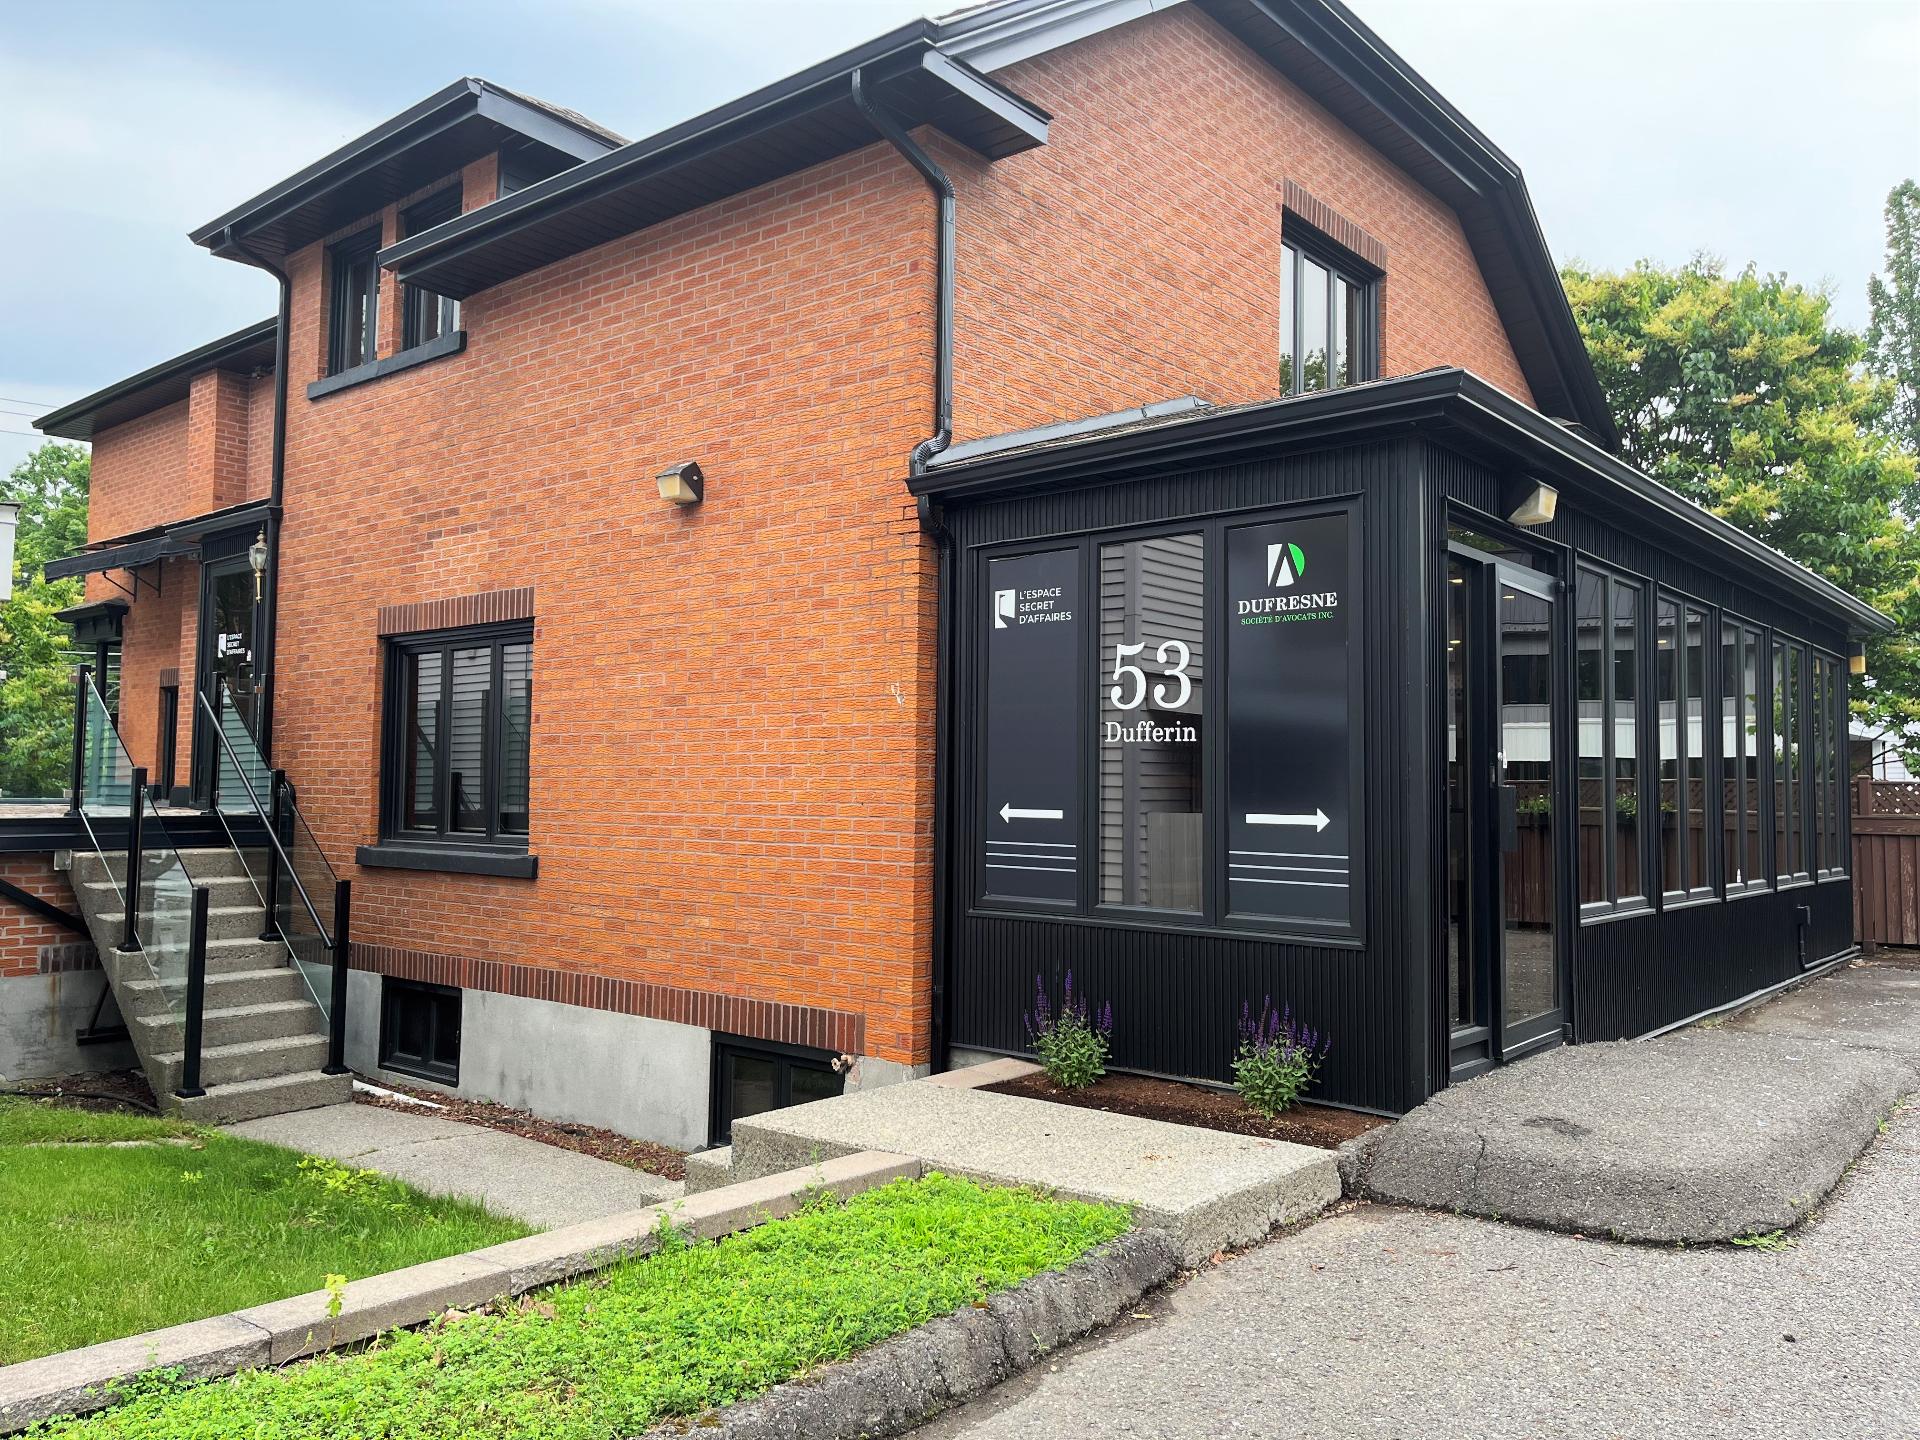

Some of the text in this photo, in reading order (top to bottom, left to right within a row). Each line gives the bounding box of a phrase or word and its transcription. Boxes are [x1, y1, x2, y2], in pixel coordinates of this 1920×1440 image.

[1019, 588, 1061, 599] L'ESPACE
[1019, 600, 1054, 611] SECRET
[1238, 592, 1337, 615] DUFRESNE
[1019, 612, 1071, 624] D'AFFAIRES
[1275, 612, 1316, 623] D'AVOCATS
[1110, 640, 1192, 710] 53
[1104, 720, 1197, 743] Dufferin
